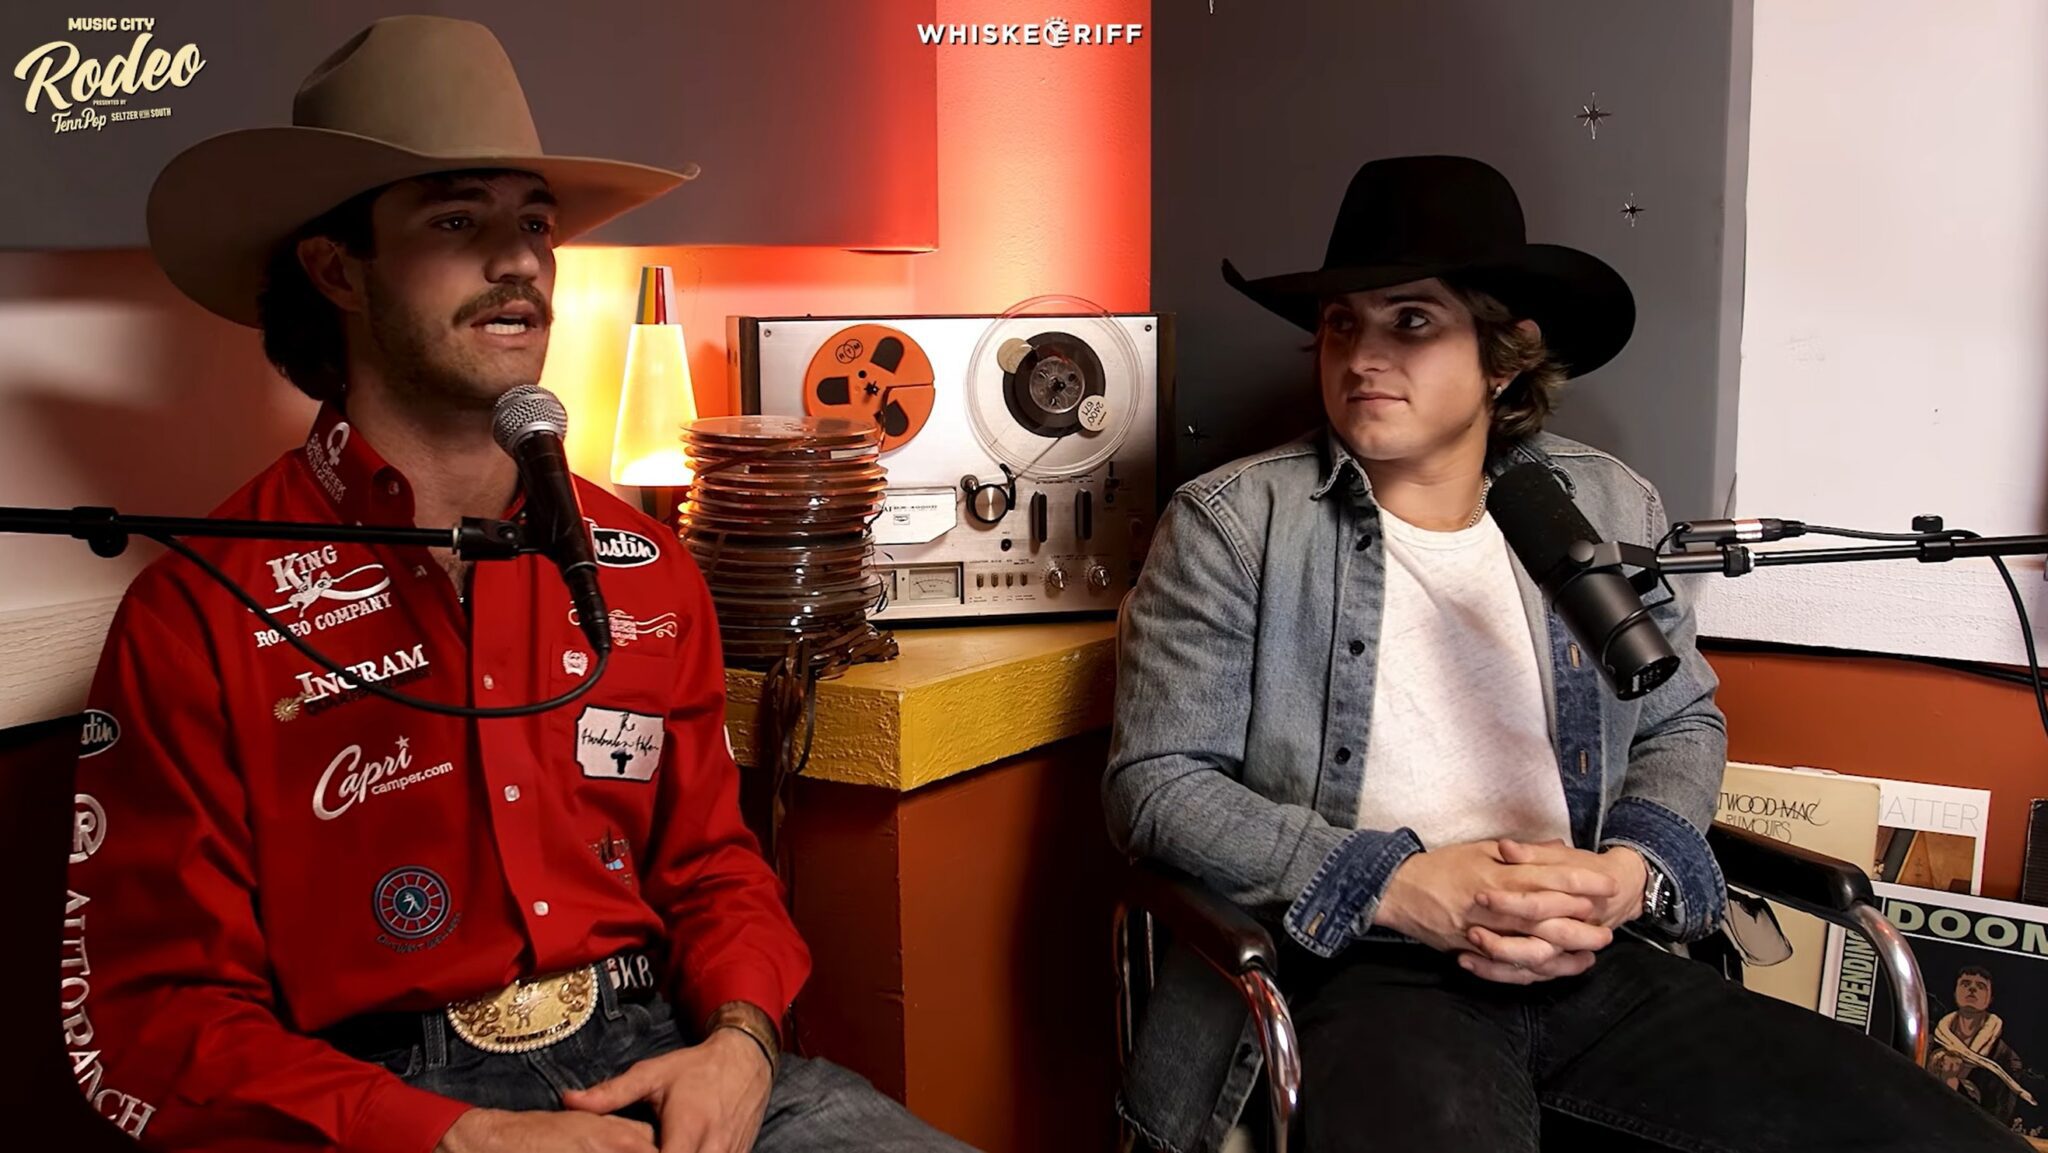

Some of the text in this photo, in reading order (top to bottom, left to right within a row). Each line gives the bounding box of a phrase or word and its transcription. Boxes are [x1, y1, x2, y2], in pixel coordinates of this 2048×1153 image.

[595, 532, 655, 558] ustin
[266, 544, 338, 593] KING
[314, 592, 392, 631] COMPANY
[254, 620, 312, 648] ROEO
[80, 713, 115, 746] stin
[312, 736, 413, 821] Capri
[371, 761, 455, 795] camper.com
[1718, 792, 1777, 816] TWOOD
